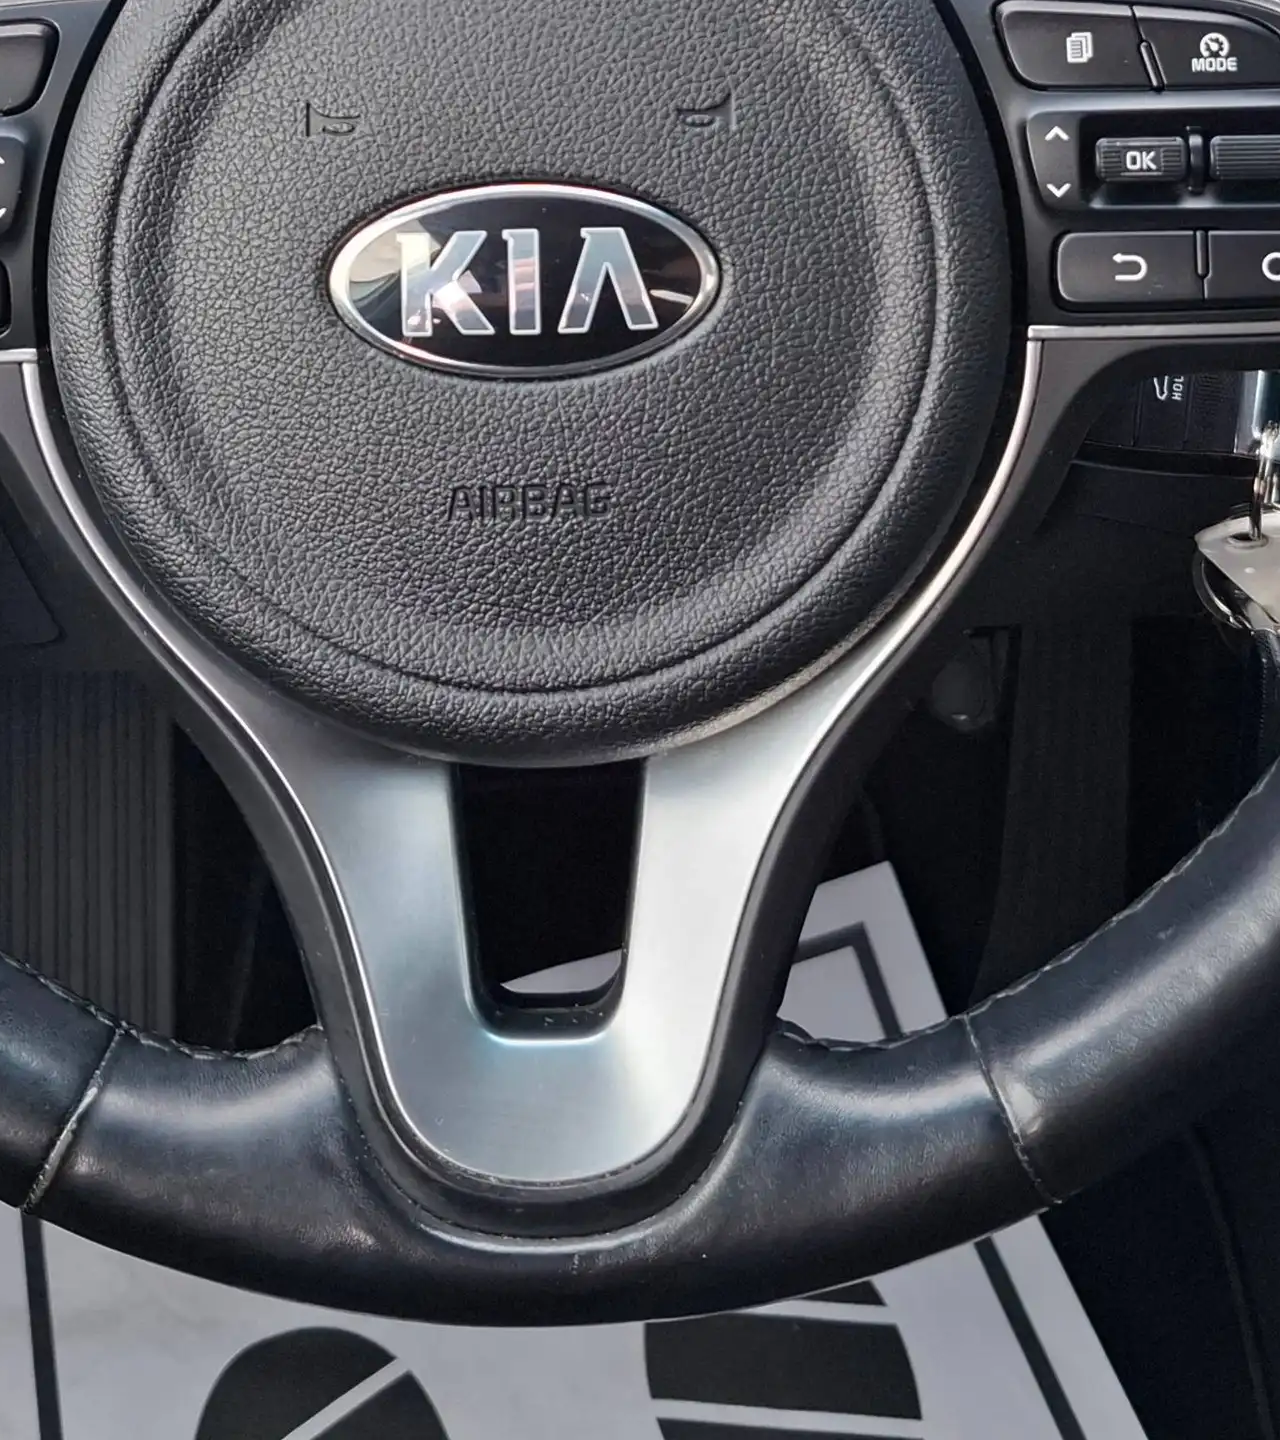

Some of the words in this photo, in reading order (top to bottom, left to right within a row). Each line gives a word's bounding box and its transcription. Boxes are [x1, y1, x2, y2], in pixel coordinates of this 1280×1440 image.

[1191, 57, 1237, 71] MODE
[1126, 152, 1156, 170] OK
[396, 227, 658, 336] KIA
[448, 484, 611, 521] AIRBAG
